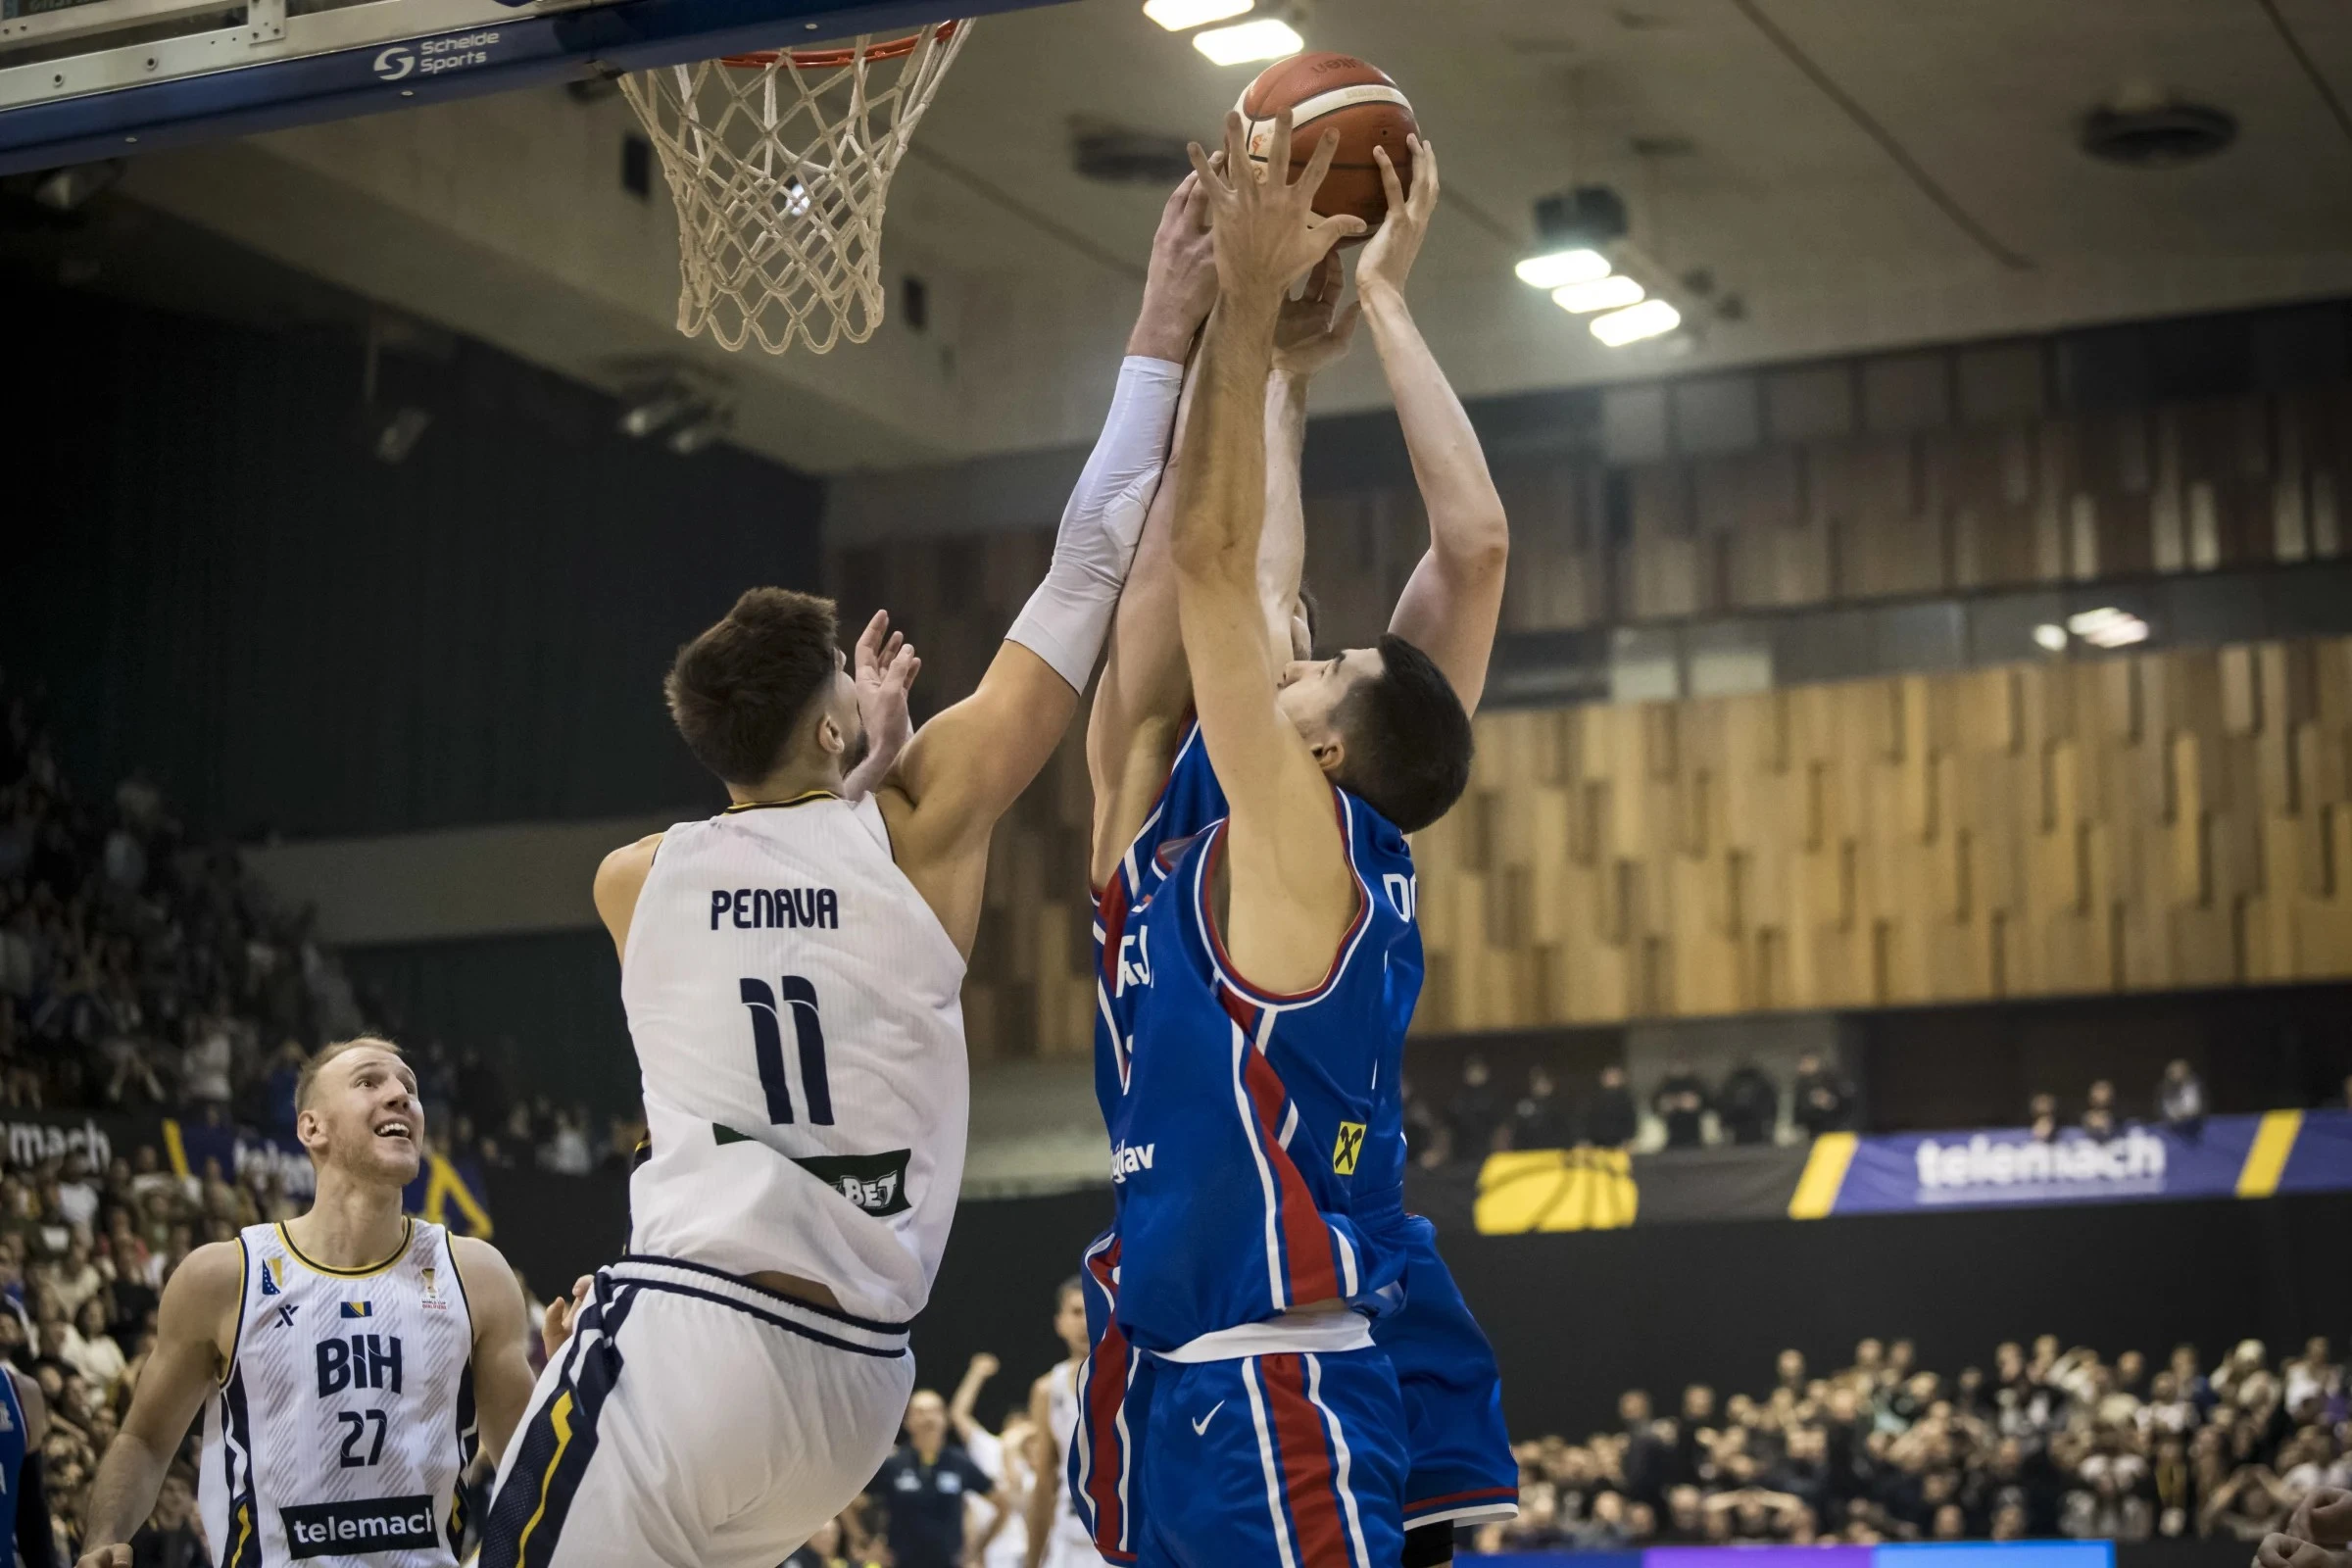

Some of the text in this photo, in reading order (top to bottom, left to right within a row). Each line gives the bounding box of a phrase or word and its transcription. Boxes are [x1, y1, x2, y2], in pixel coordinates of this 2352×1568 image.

[420, 32, 500, 55] Schelde
[420, 51, 487, 74] Sports
[710, 888, 839, 931] PENAVA
[740, 975, 835, 1125] 11
[0, 1117, 112, 1174] mach
[1916, 1128, 2166, 1187] telemach
[833, 1170, 898, 1209] BET
[316, 1334, 403, 1399] BIH
[338, 1408, 388, 1468] 27
